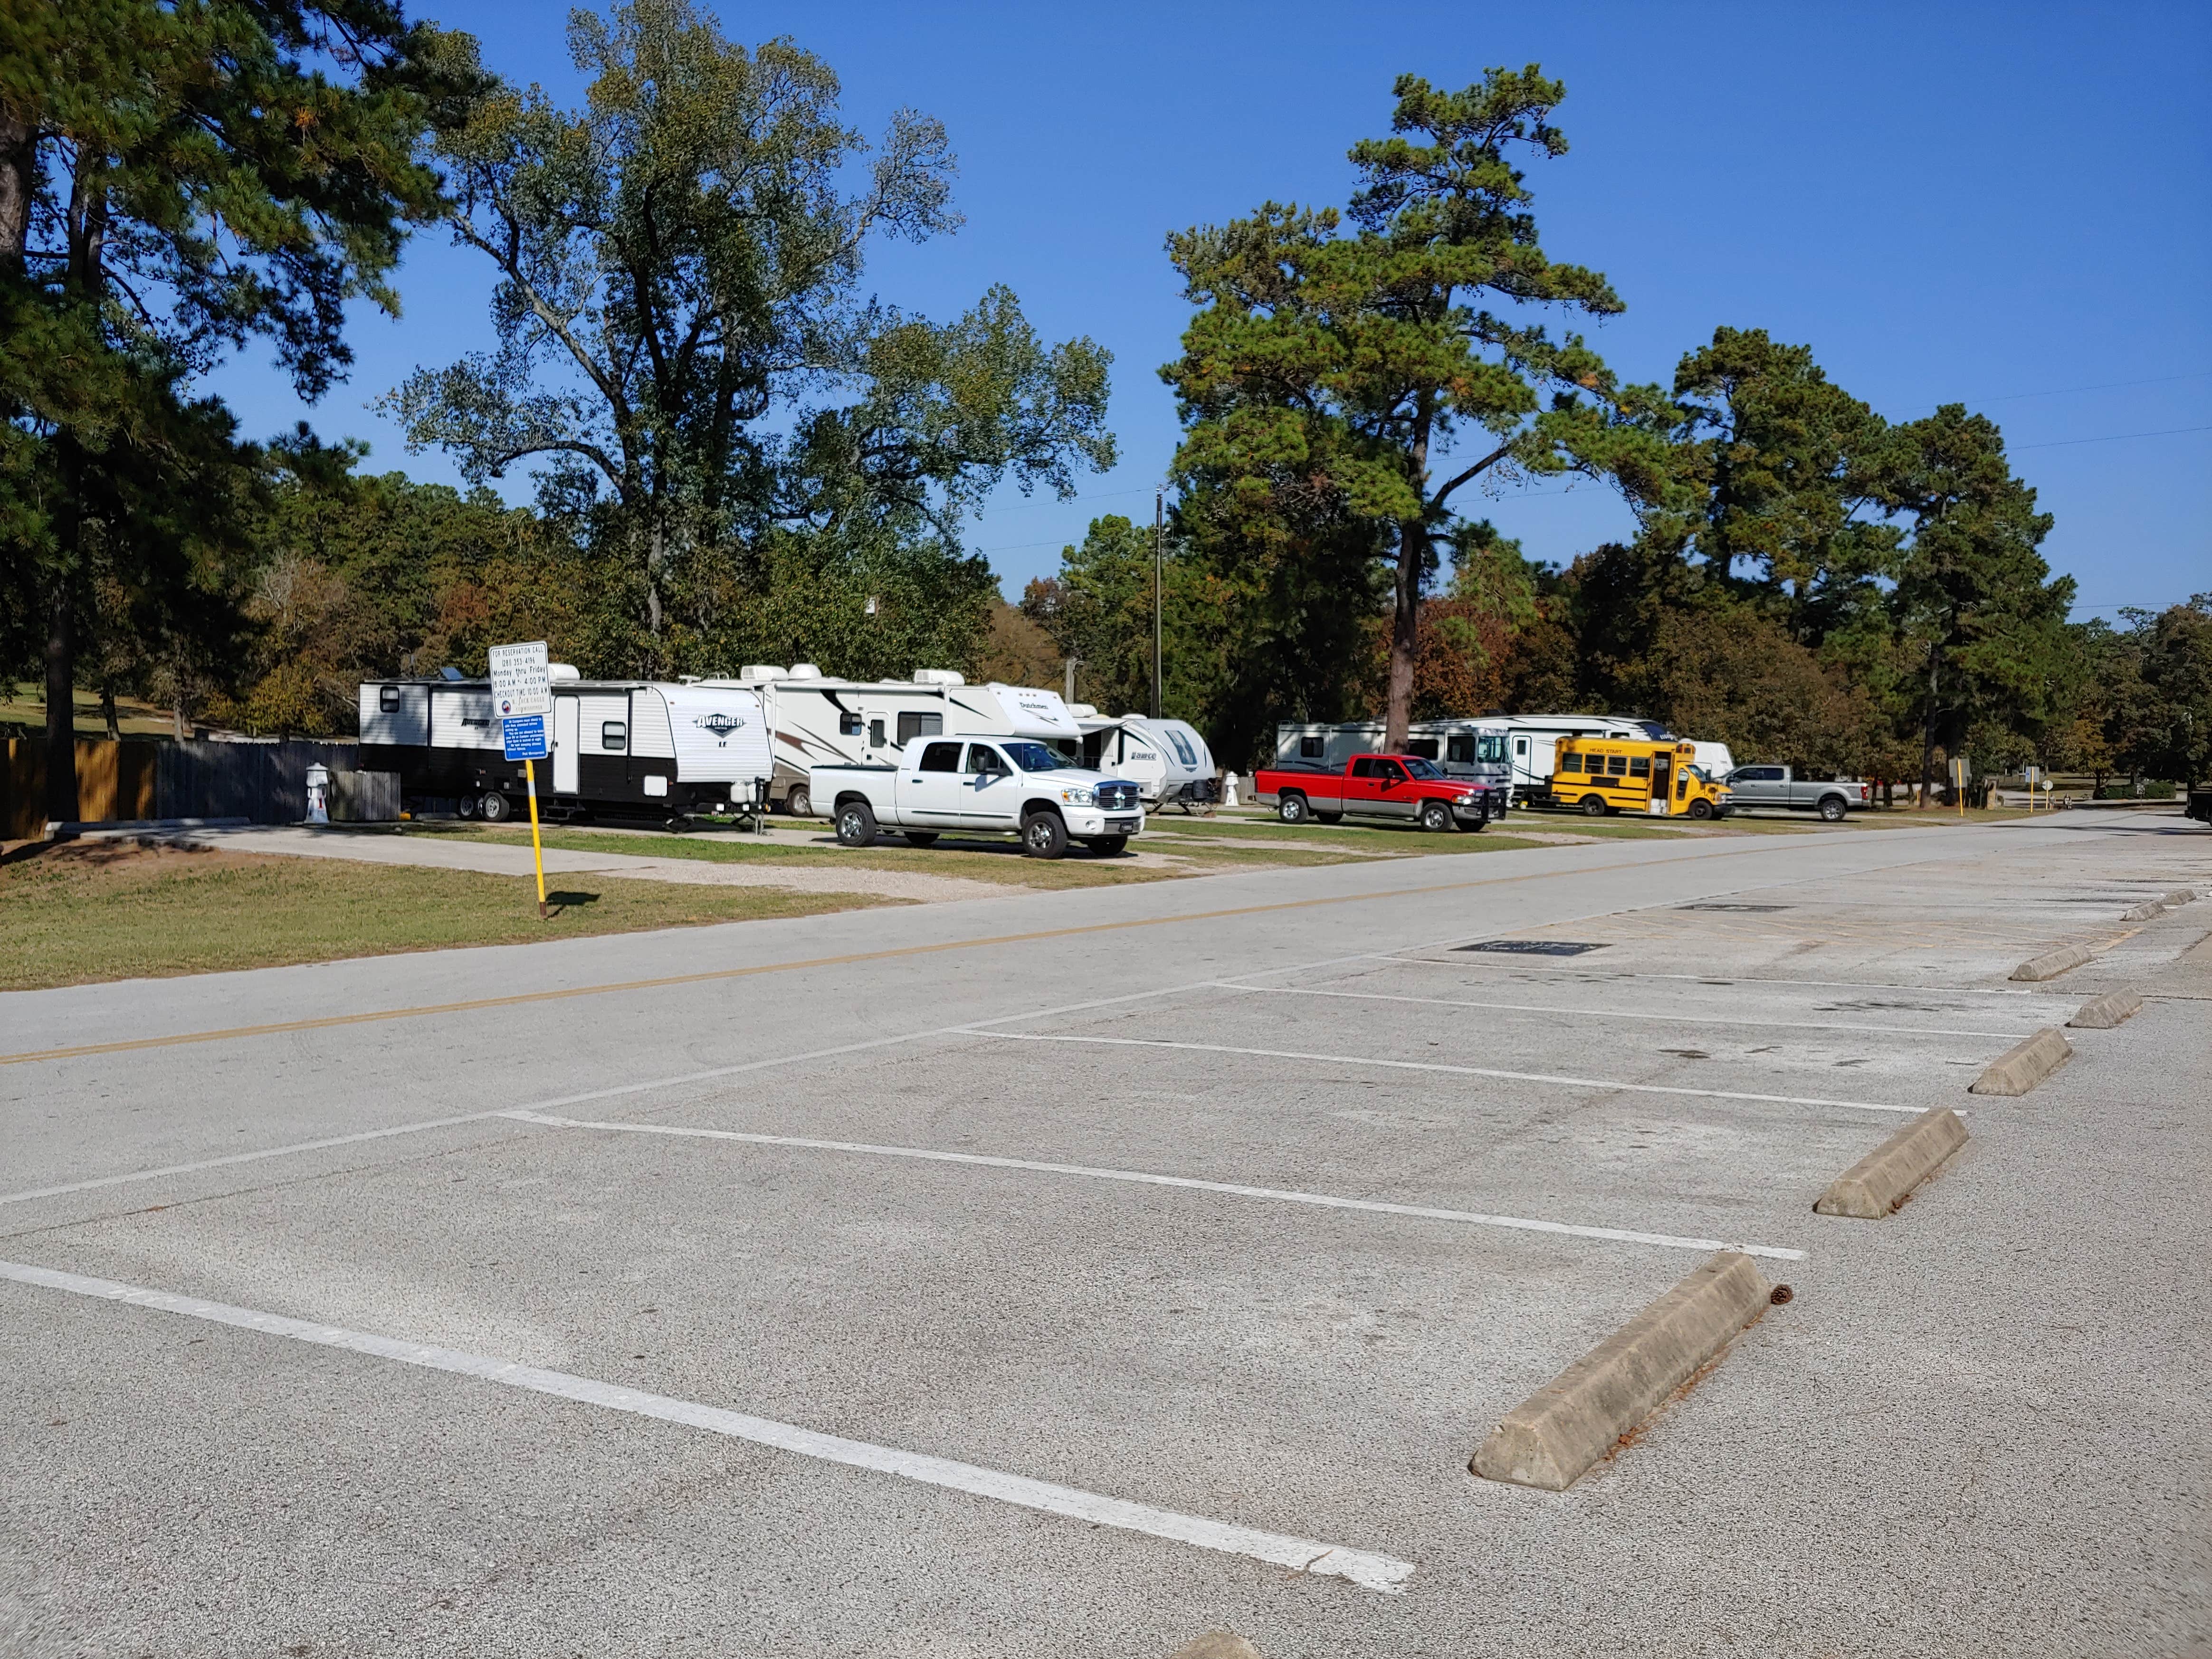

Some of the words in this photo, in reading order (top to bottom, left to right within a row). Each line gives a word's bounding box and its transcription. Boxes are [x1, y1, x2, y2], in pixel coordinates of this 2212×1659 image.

[503, 647, 531, 657] RESERVATION
[516, 667, 526, 676] thru
[530, 666, 545, 674] Friday
[495, 689, 515, 699] CHECKOUT
[696, 715, 744, 728] AVENGER
